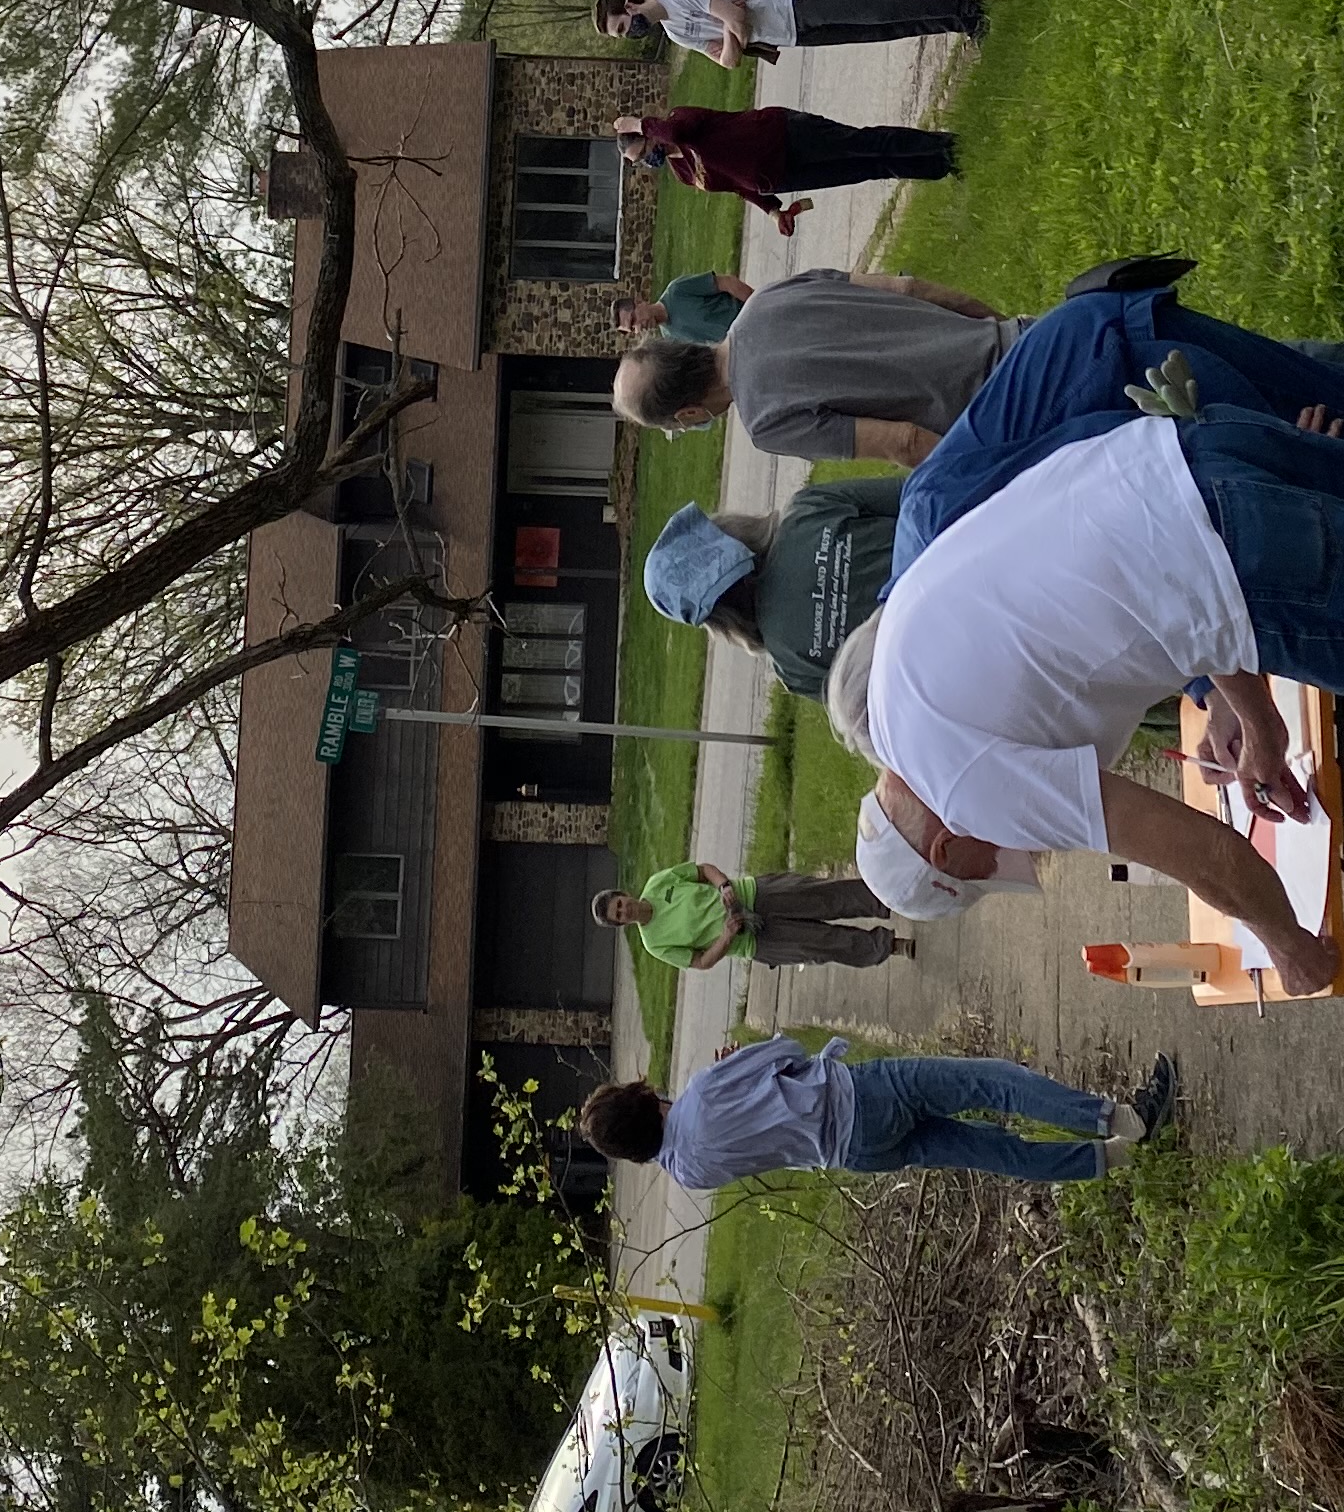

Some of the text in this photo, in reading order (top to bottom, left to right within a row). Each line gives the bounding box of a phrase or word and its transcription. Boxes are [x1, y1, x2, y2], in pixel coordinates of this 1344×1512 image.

[320, 654, 357, 758] RAMBLE RD W
